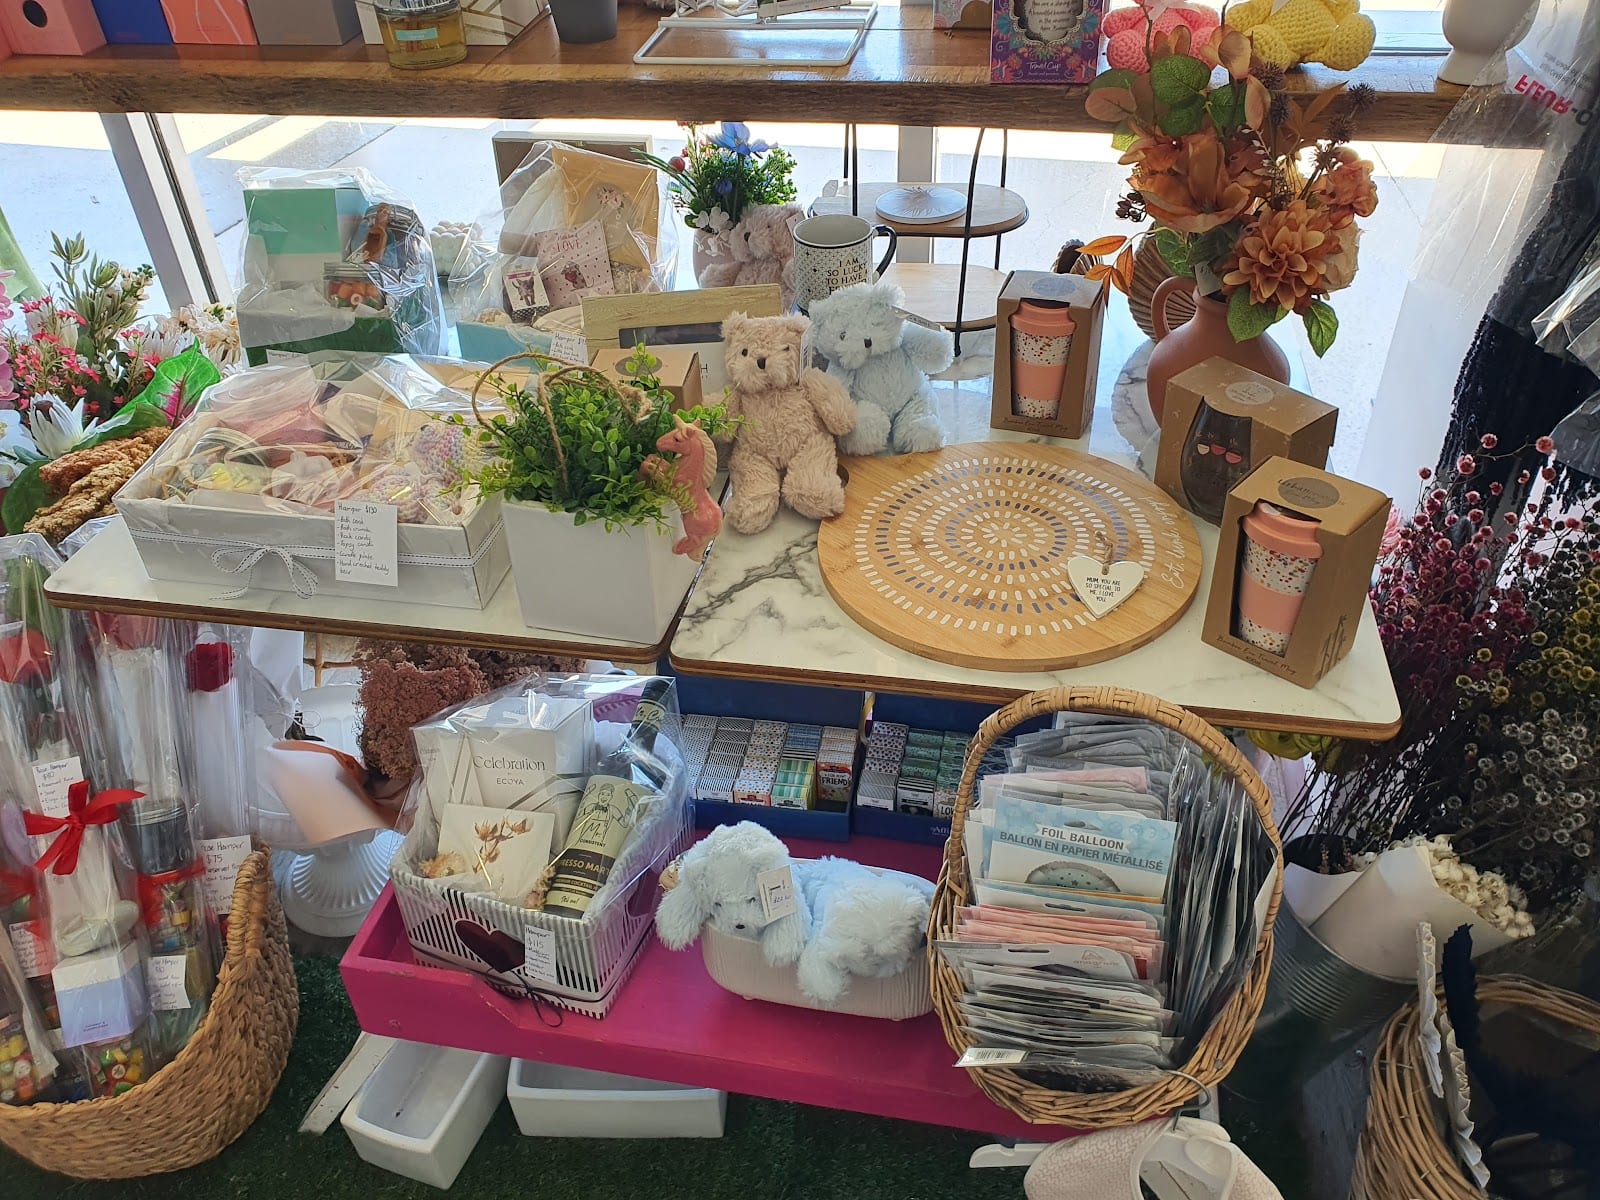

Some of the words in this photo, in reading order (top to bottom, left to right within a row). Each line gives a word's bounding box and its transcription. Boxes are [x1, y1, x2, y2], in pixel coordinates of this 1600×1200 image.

[845, 257, 859, 266] AM
[827, 269, 840, 277] SO
[843, 262, 867, 275] LUCKY
[841, 274, 862, 283] HAVE
[473, 755, 546, 771] Celebration
[496, 777, 525, 785] ECOYA
[821, 776, 848, 786] FRIEND
[1041, 827, 1066, 841] FOIL
[1069, 833, 1125, 850] BALLOON
[216, 840, 245, 851] Hamper
[1000, 831, 1042, 849] BALLON
[1044, 840, 1059, 851] EN
[1061, 842, 1100, 860] PAPIER
[1102, 851, 1164, 871] MÉTALLISÉ
